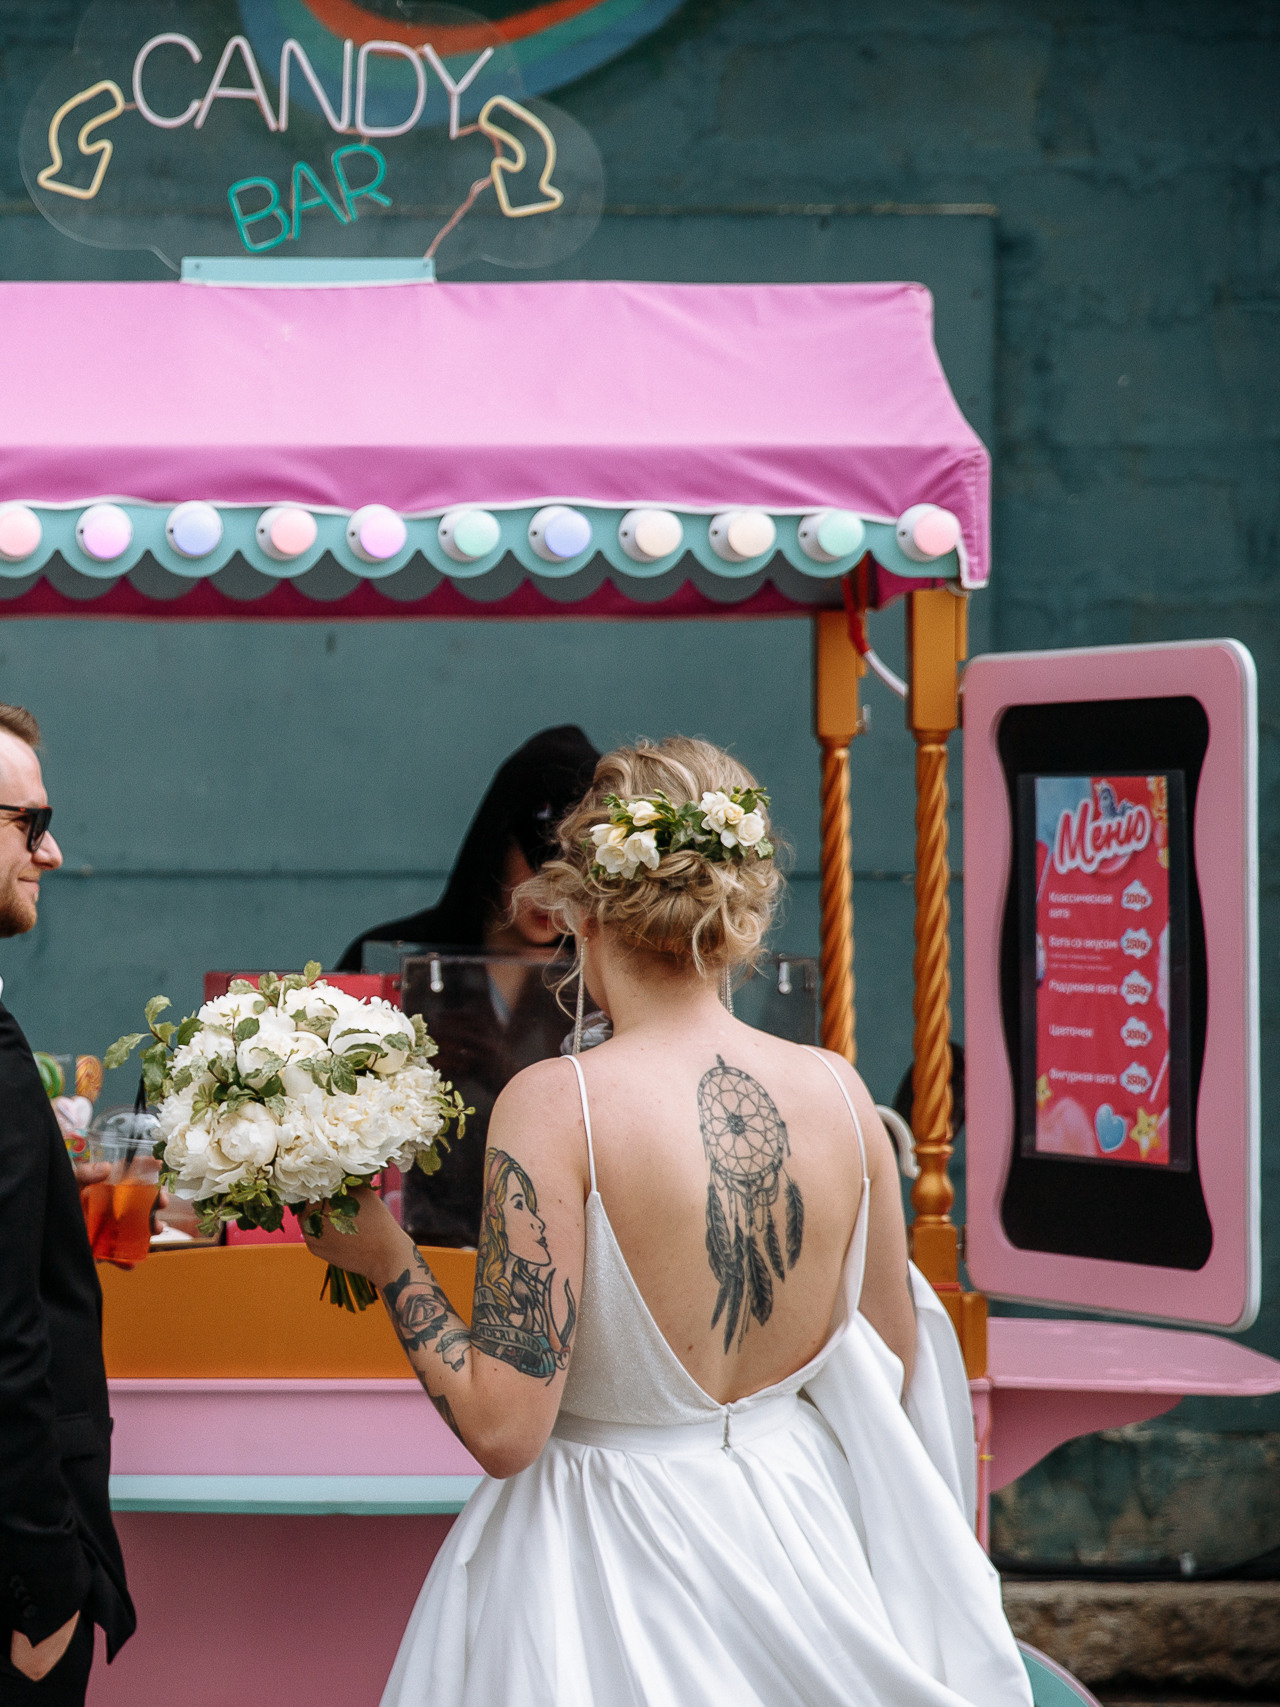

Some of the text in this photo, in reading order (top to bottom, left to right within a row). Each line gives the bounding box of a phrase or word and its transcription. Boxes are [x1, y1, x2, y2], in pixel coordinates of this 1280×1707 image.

[132, 33, 494, 139] CANDY
[227, 143, 392, 252] BAR
[1056, 800, 1150, 870] Меню
